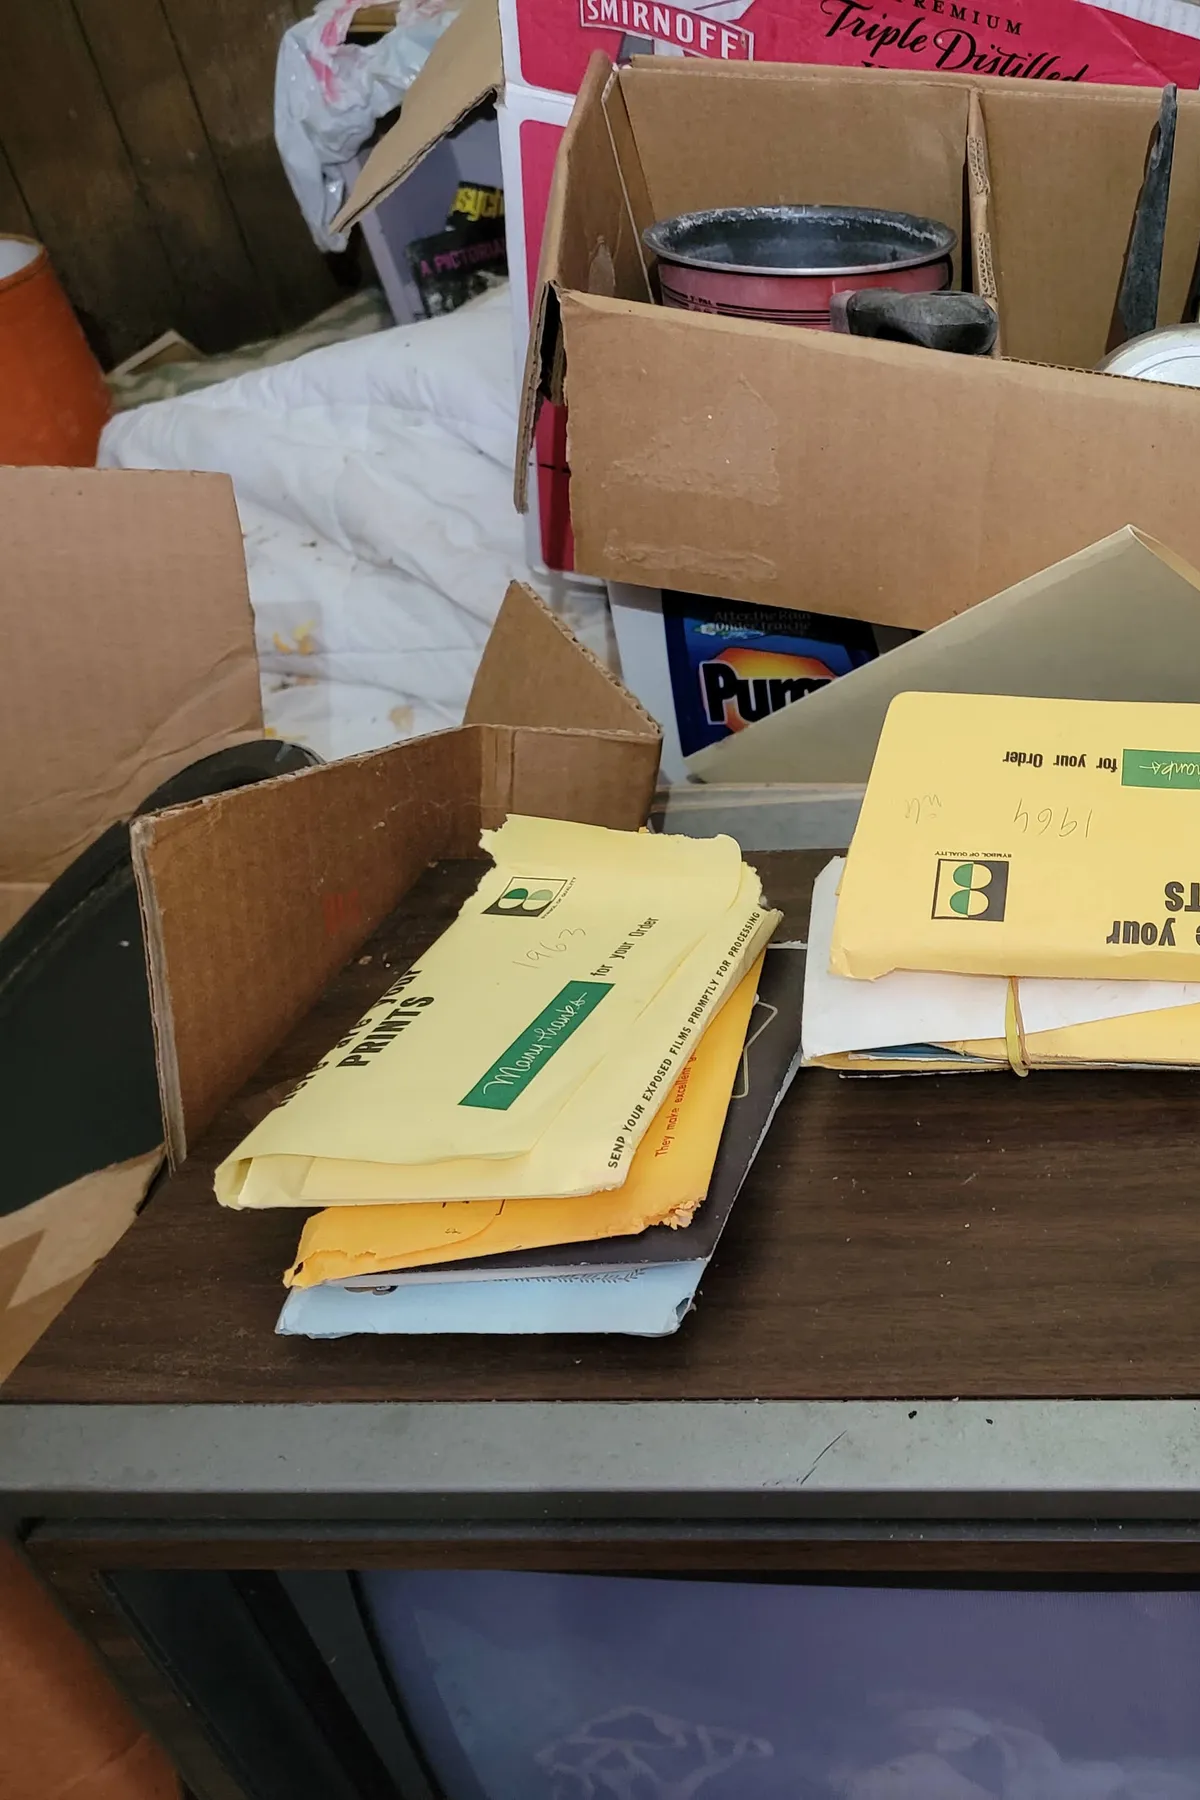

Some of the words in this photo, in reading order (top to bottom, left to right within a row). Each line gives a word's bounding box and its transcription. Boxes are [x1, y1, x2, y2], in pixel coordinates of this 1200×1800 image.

[587, 0, 739, 59] SMIRNOFF
[820, 0, 928, 58] Triple
[895, 0, 1023, 36] REMIUM
[1002, 749, 1044, 768] Order
[1053, 753, 1087, 770] your
[1095, 755, 1118, 773] for
[1013, 797, 1094, 839] 1964
[512, 928, 586, 969] 1963
[1105, 917, 1176, 947] your
[483, 1043, 553, 1095] Many
[534, 991, 588, 1043] thanks
[590, 964, 613, 977] for
[609, 941, 634, 960] your
[628, 917, 660, 940] Order
[336, 996, 435, 1068] PRINTS
[608, 1135, 626, 1169] SEND
[622, 1104, 646, 1134] YOUR
[642, 1058, 673, 1102] EXPOSED
[669, 1027, 692, 1055] FILMS
[688, 978, 720, 1025] PROMPTLY
[716, 959, 731, 978] FOR
[728, 911, 761, 957] PROCESSING
[654, 1135, 676, 1158] They
[666, 1107, 681, 1131] make
[674, 1061, 691, 1103] excellent
